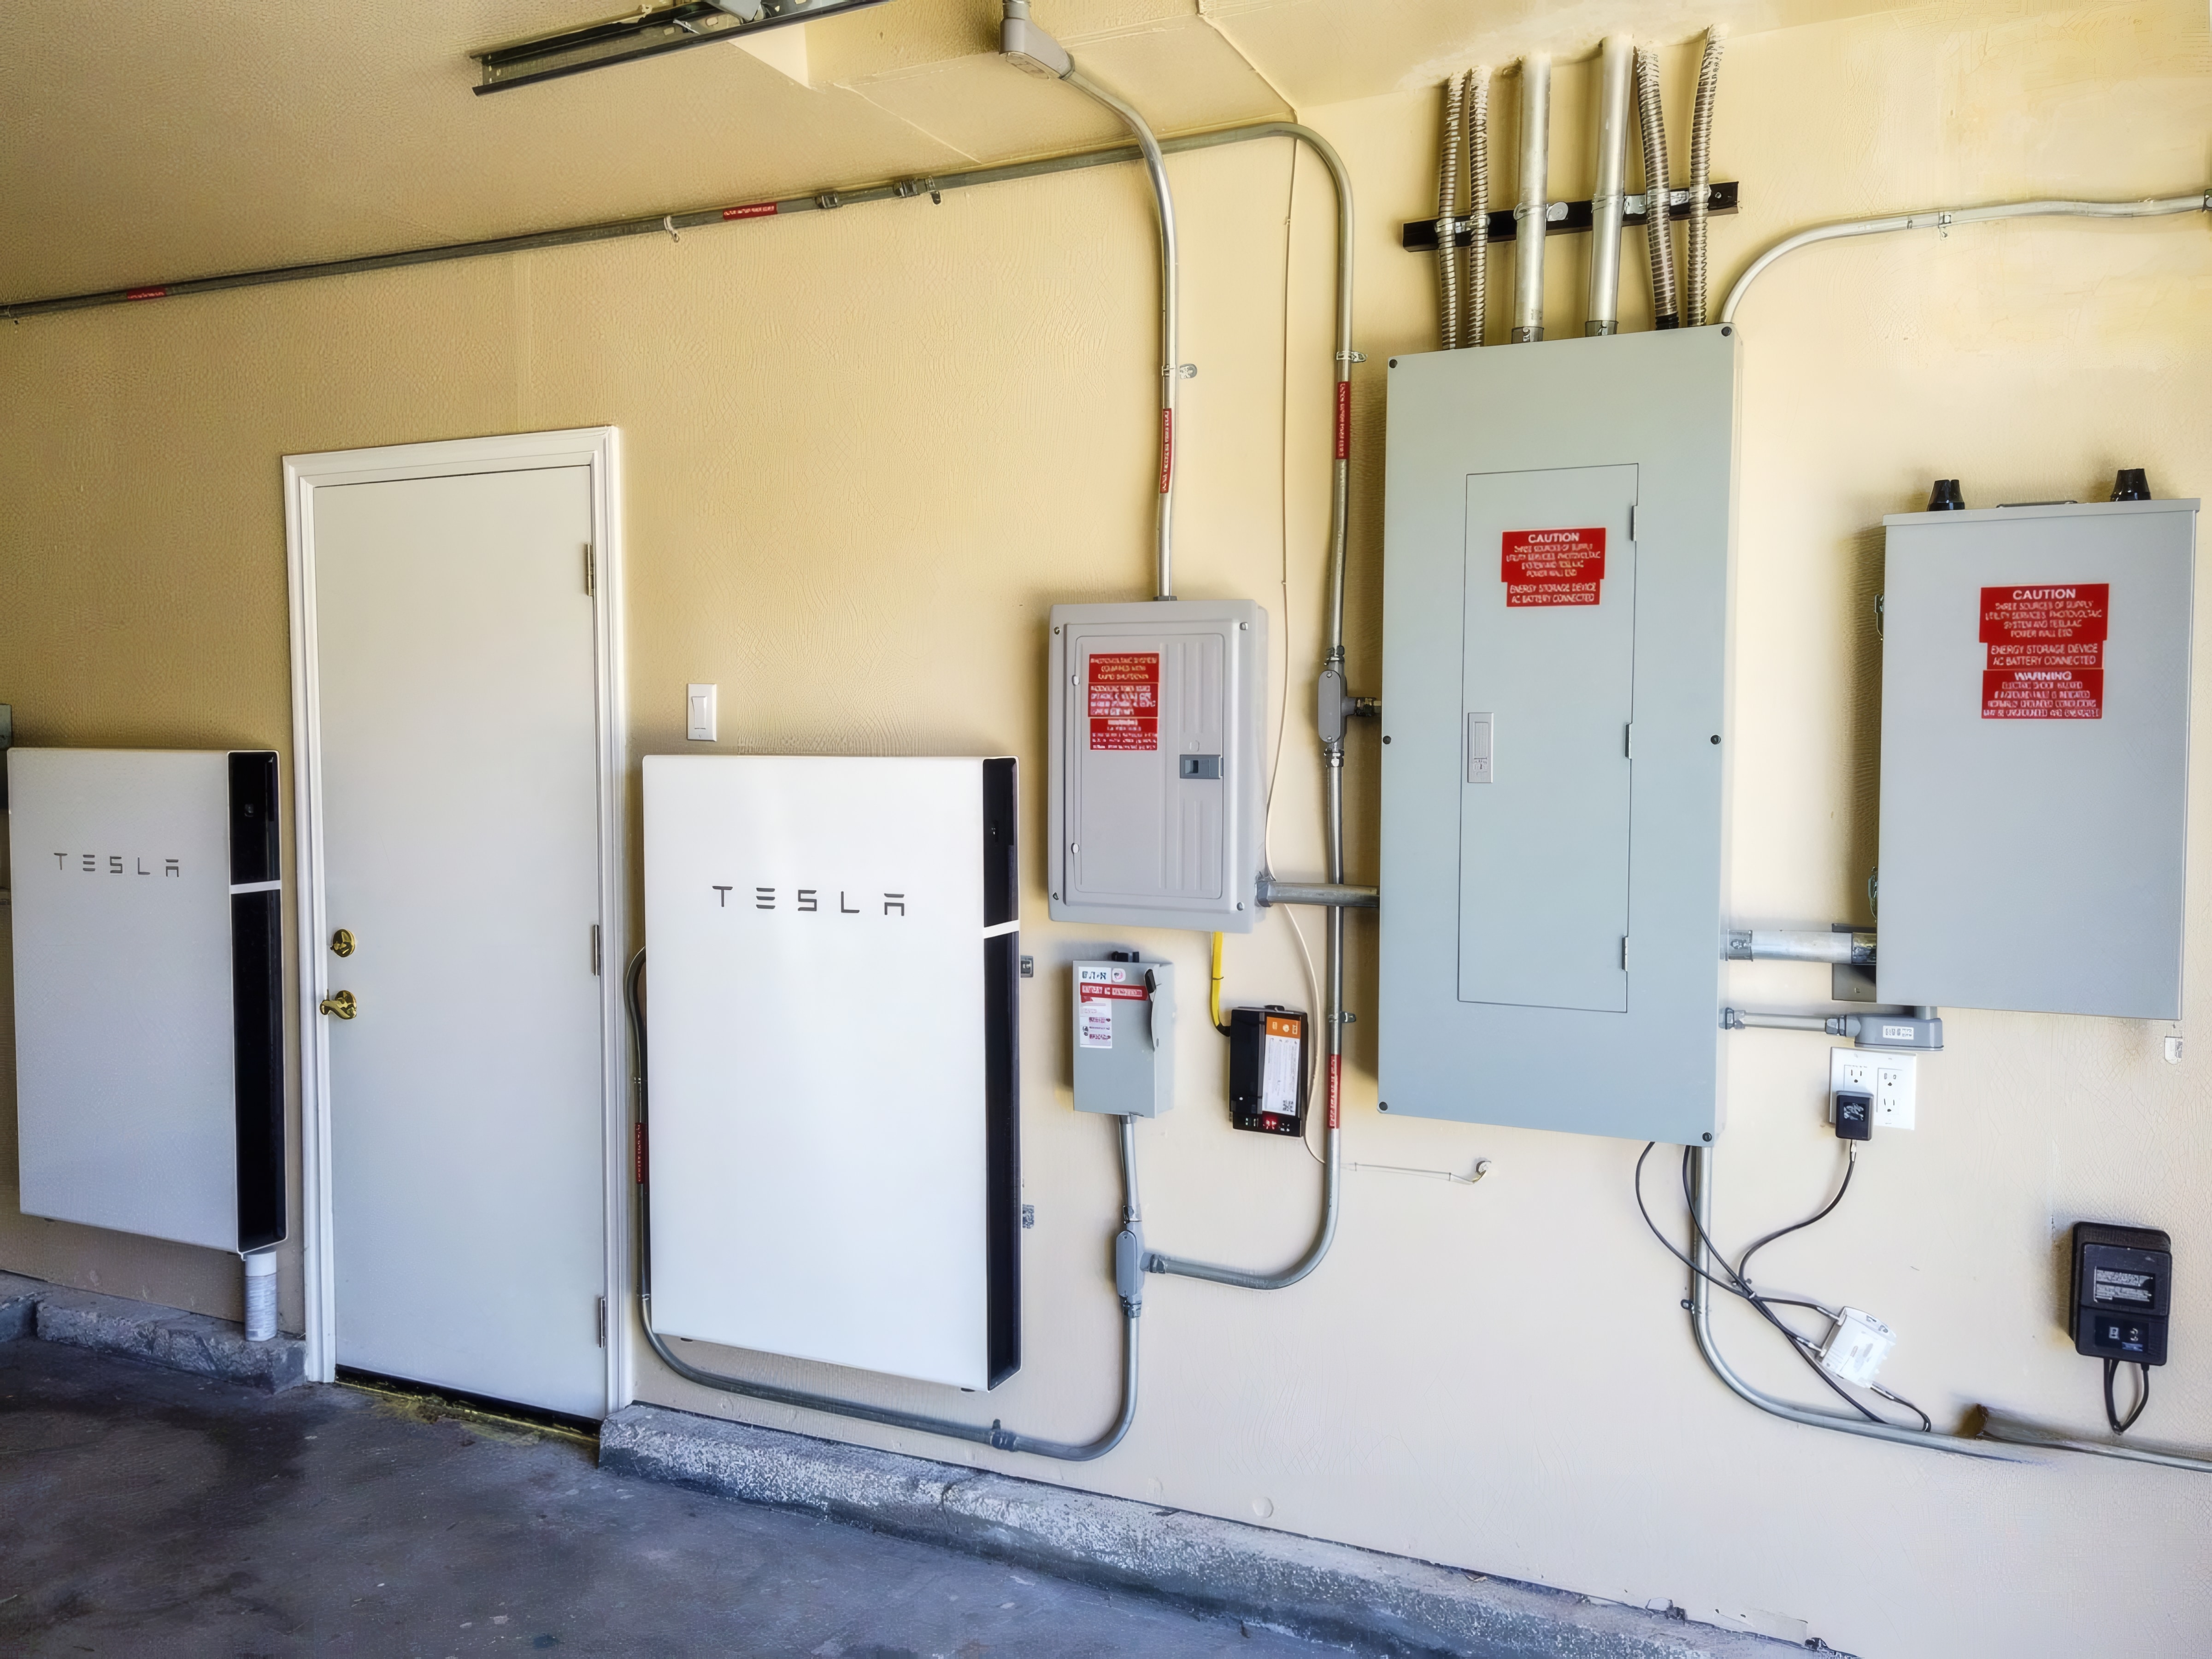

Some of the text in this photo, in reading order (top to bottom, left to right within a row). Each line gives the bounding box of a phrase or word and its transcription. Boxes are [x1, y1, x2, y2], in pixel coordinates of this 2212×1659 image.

[1528, 533, 1580, 543] CAUTION
[2012, 588, 2076, 600] CAUTION
[1991, 643, 2098, 655] ENERGY STORAGE DEVICE
[1993, 655, 2096, 666] AC BATTERY CONNECTED
[53, 853, 179, 877] TESLA
[712, 885, 905, 917] TESLA
